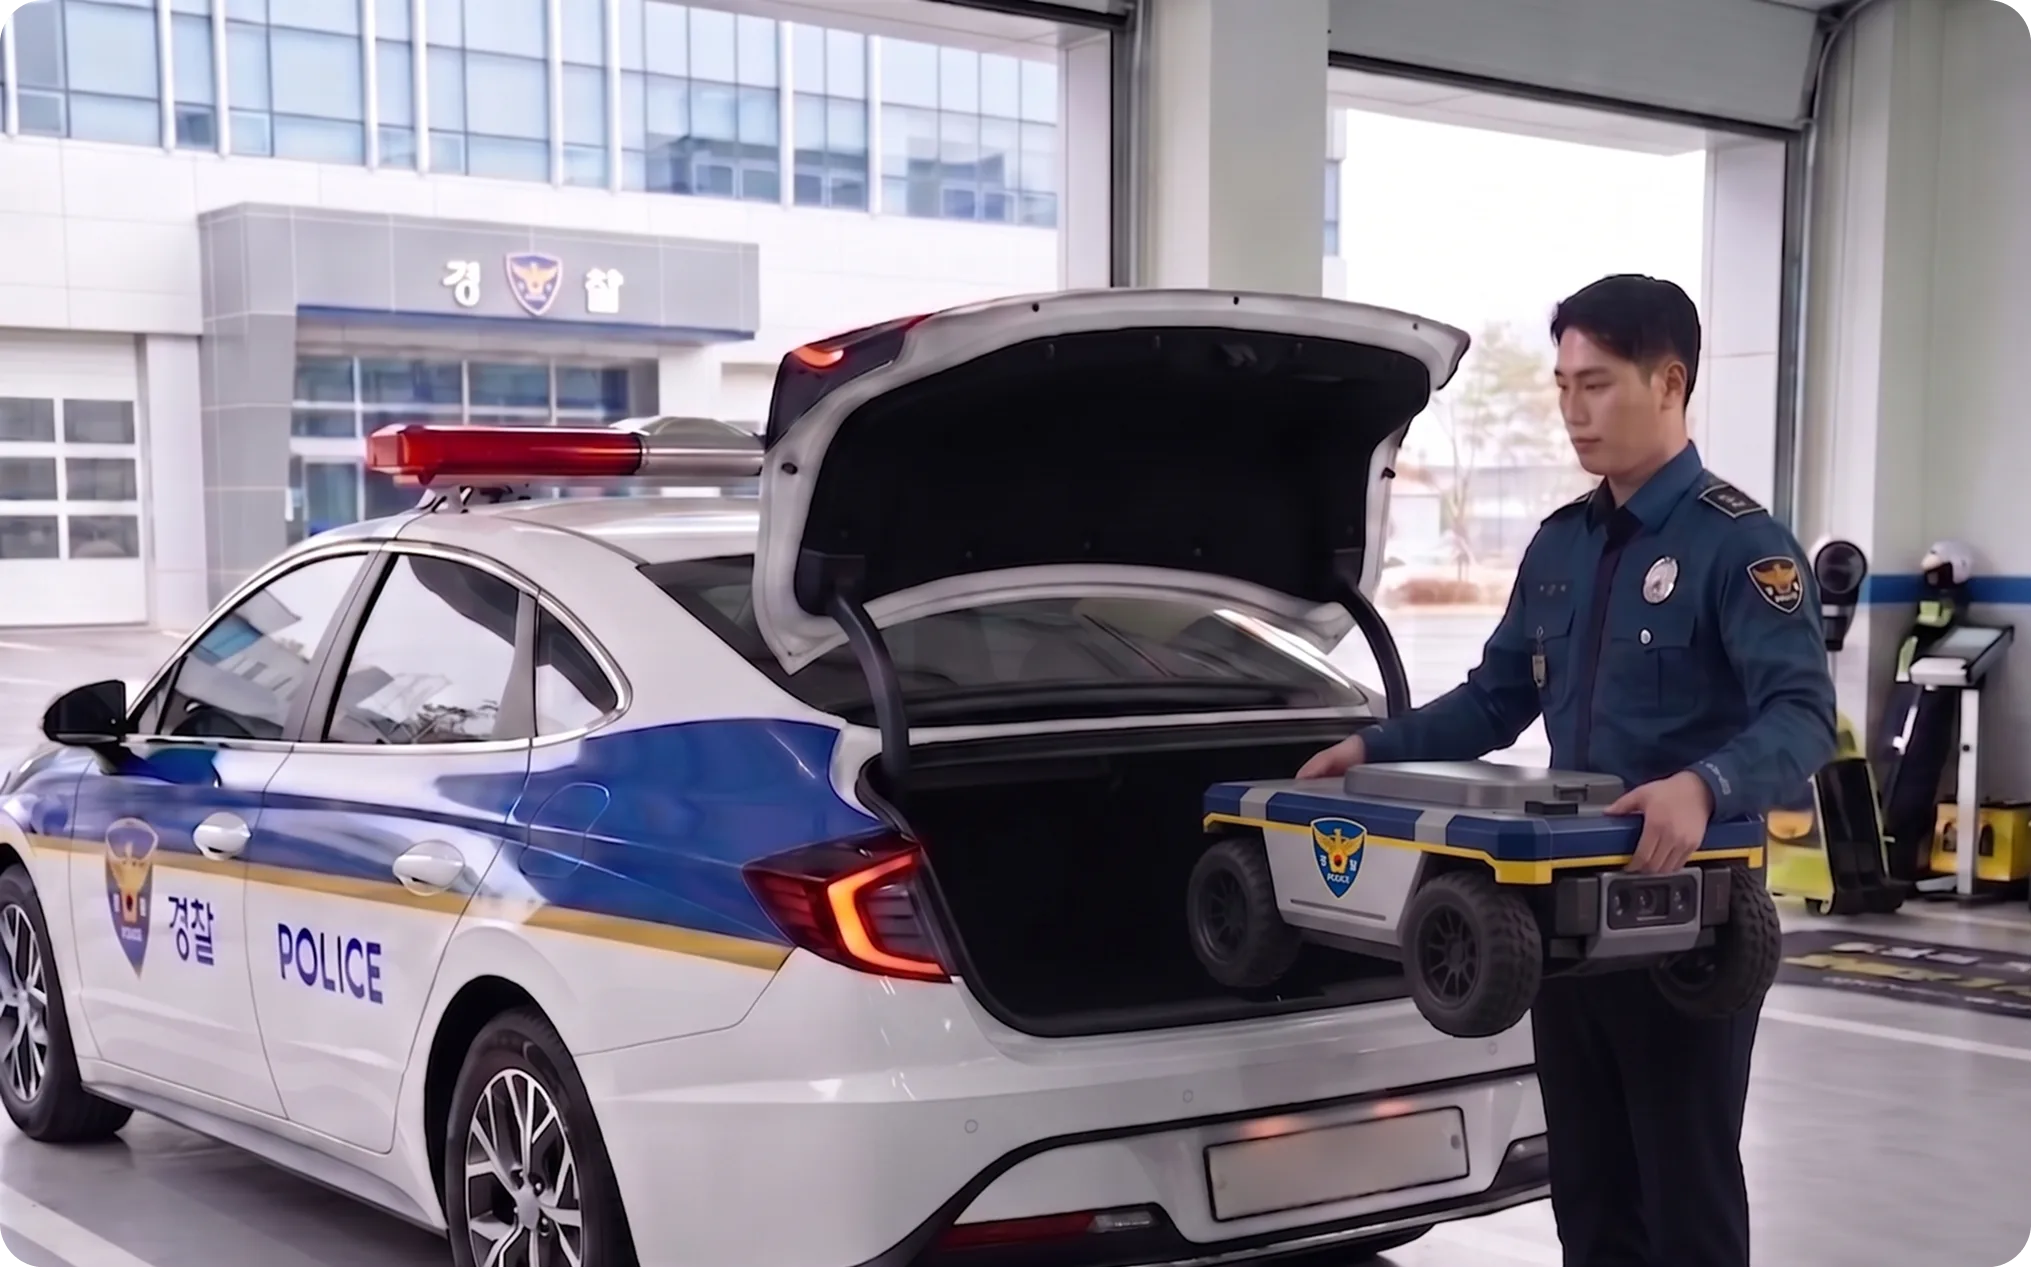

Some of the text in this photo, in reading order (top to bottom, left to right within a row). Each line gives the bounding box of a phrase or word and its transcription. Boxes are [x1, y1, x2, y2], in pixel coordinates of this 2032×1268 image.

[442, 261, 481, 308] 경
[168, 896, 214, 966] 경찰
[277, 923, 384, 1004] POLICE
